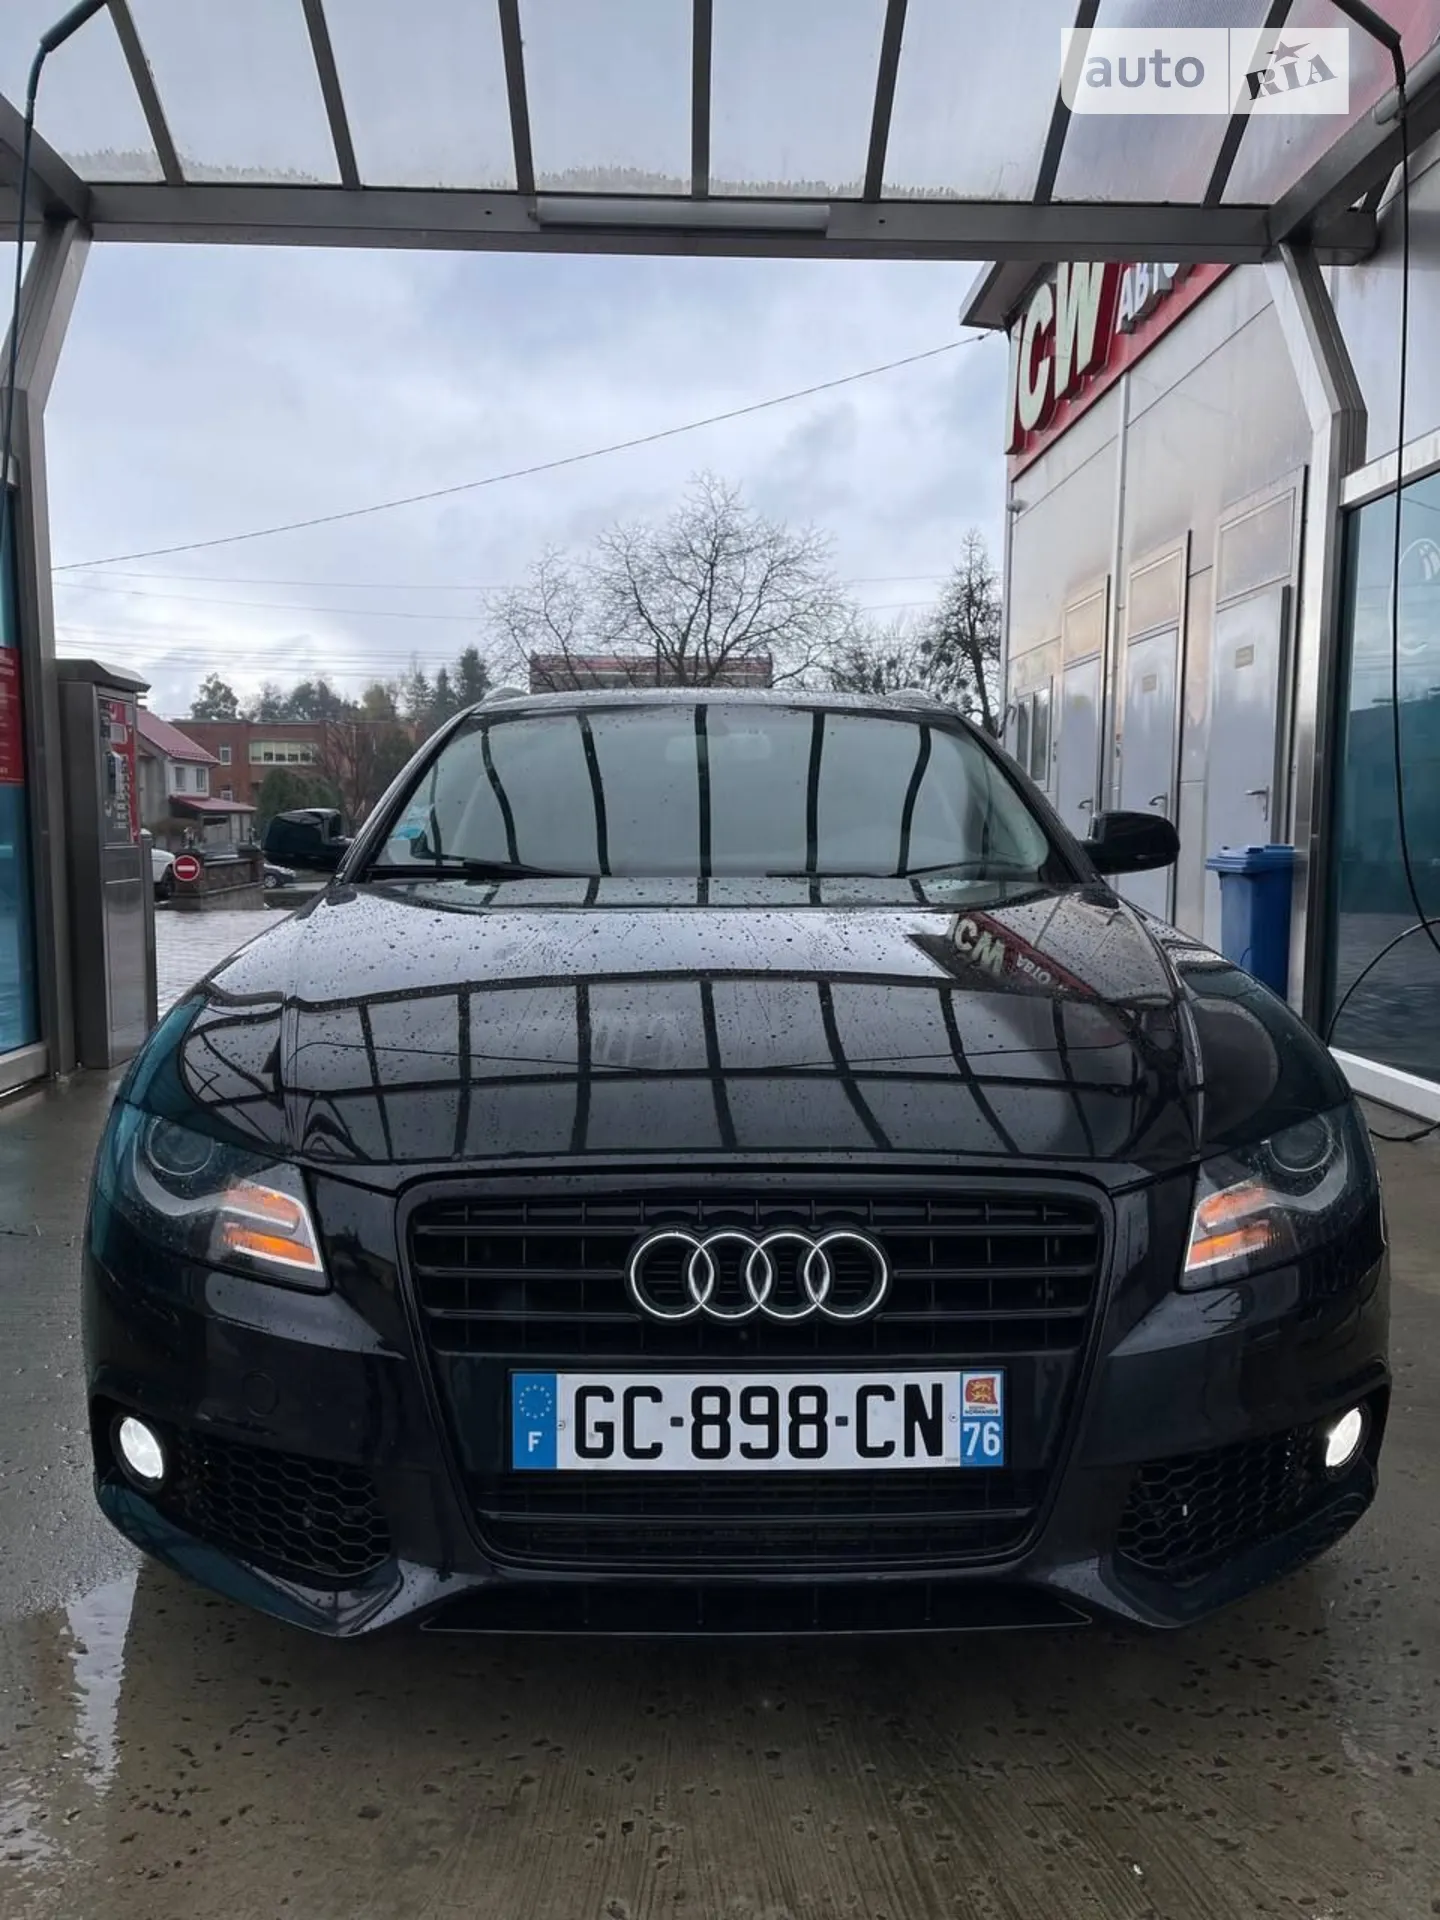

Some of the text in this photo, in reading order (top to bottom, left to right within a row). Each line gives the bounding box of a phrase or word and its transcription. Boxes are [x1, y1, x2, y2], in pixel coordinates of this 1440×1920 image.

[574, 1384, 944, 1460] GC-898-CN
[963, 1421, 1000, 1456] 76
[528, 1431, 542, 1452] F
